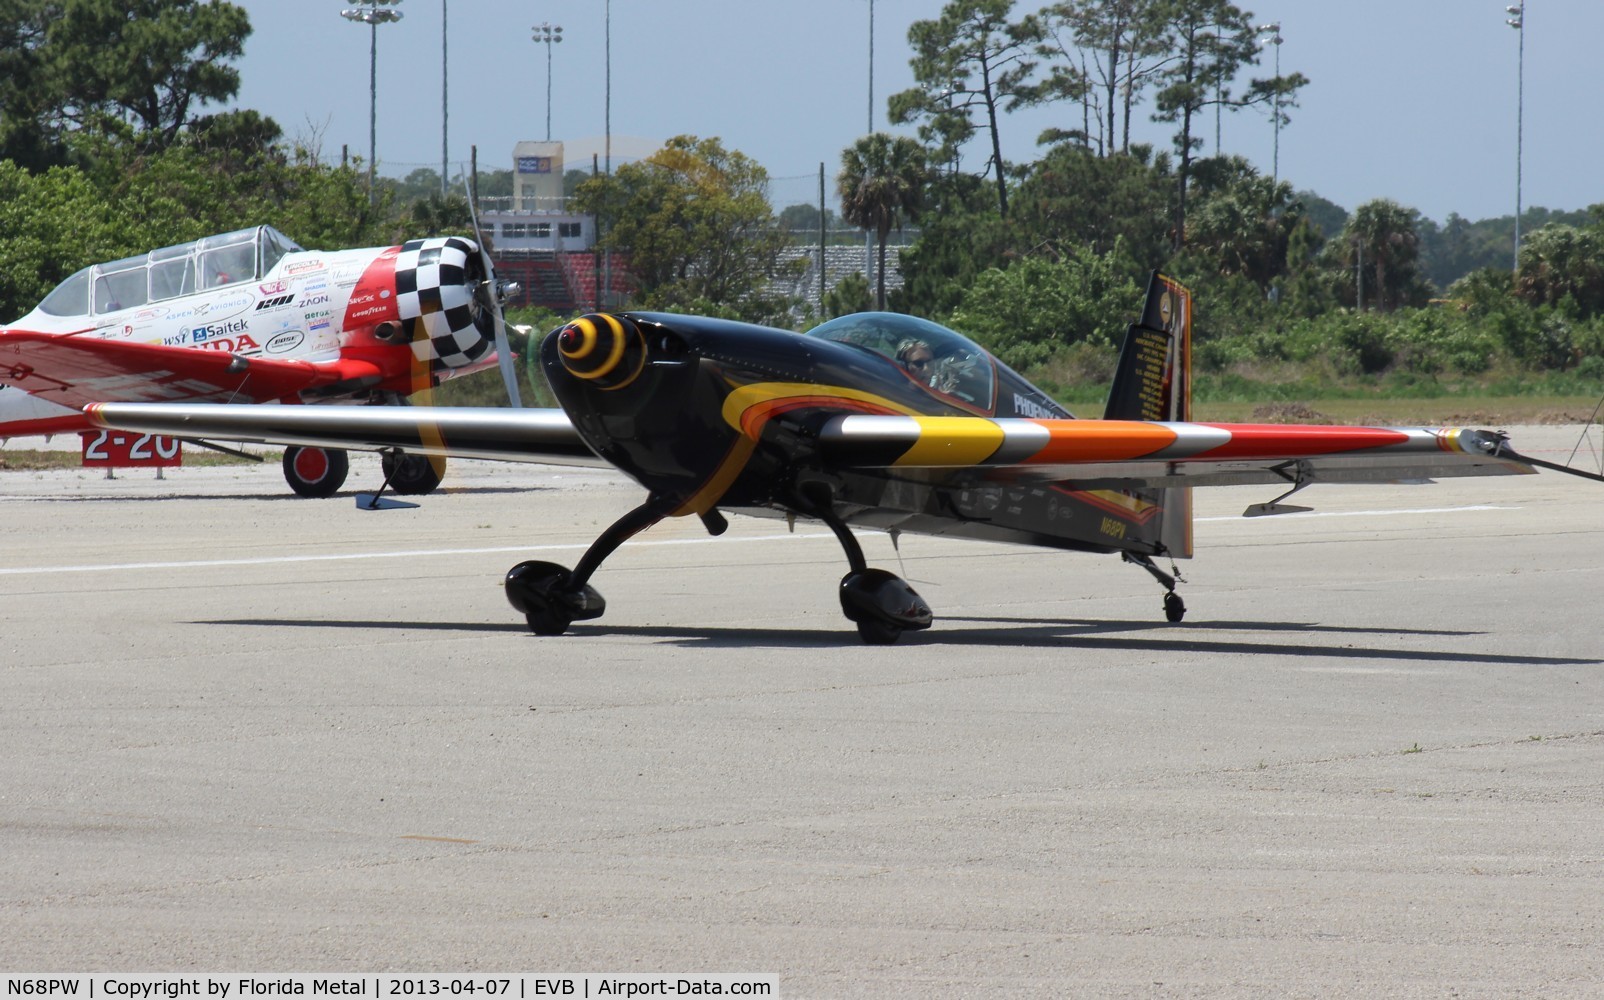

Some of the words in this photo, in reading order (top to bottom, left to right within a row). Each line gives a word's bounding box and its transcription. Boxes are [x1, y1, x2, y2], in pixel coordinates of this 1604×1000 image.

[166, 311, 192, 321] ASPEN
[209, 299, 248, 312] AVIONICS
[206, 318, 249, 338] Saitek
